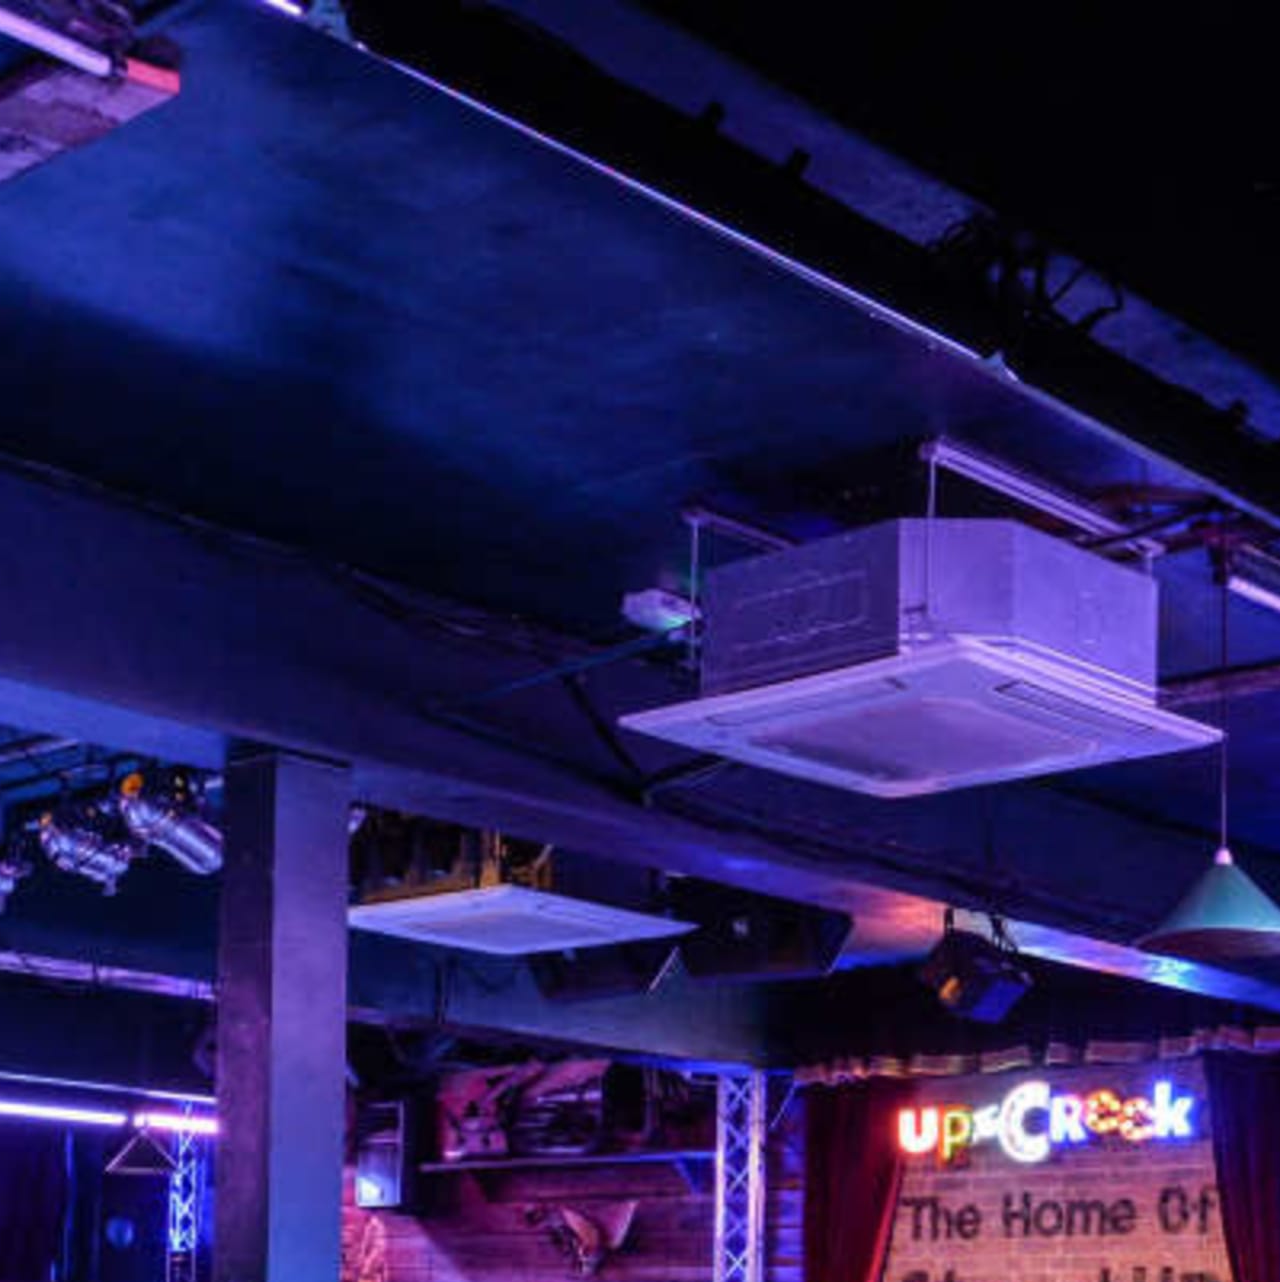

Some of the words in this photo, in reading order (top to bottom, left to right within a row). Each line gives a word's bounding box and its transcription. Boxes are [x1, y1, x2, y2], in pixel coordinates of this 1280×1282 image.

[902, 1196, 980, 1242] The
[1002, 1192, 1137, 1237] Home
[1158, 1186, 1218, 1234] Of
